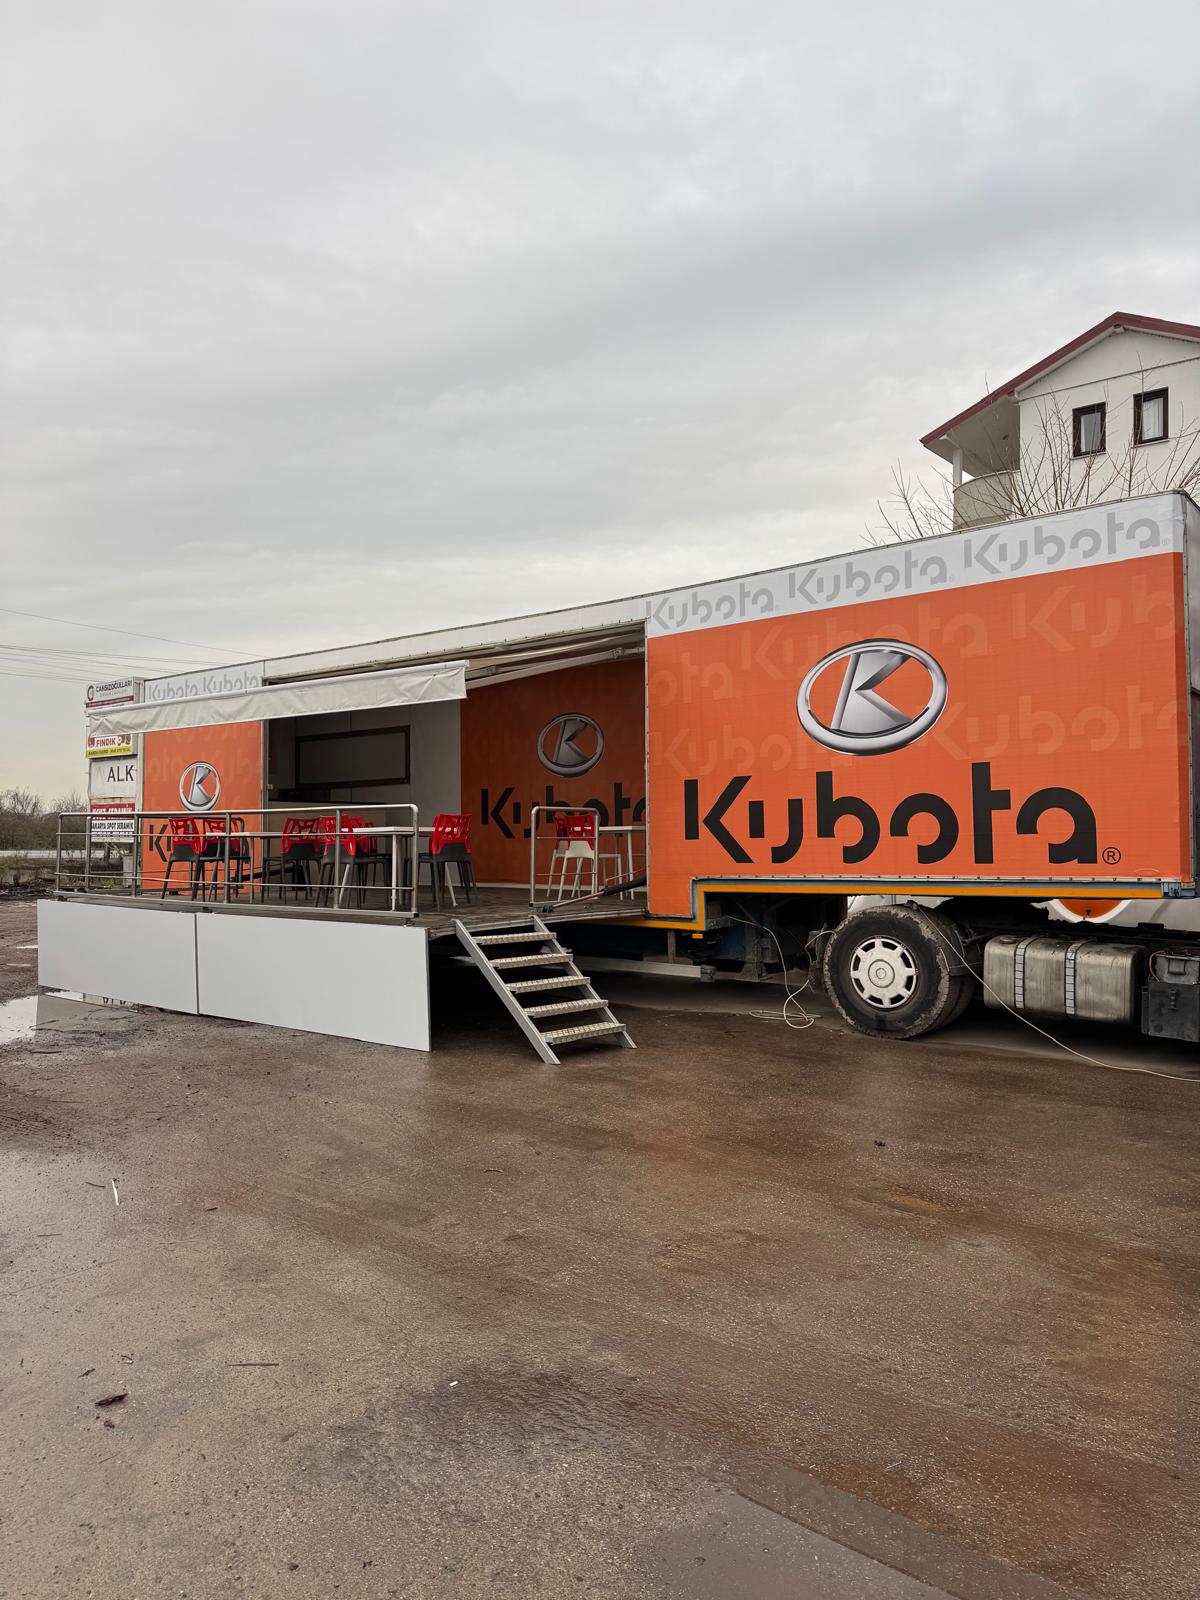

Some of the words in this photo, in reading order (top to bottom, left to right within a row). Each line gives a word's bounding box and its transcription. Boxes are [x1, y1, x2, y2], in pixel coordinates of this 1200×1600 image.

[646, 583, 775, 630] Kubota
[789, 550, 947, 605] Kubota
[965, 512, 1160, 574] Kubota
[96, 737, 116, 748] FINDIK
[107, 765, 134, 783] ALK
[684, 762, 1097, 865] Kubota
